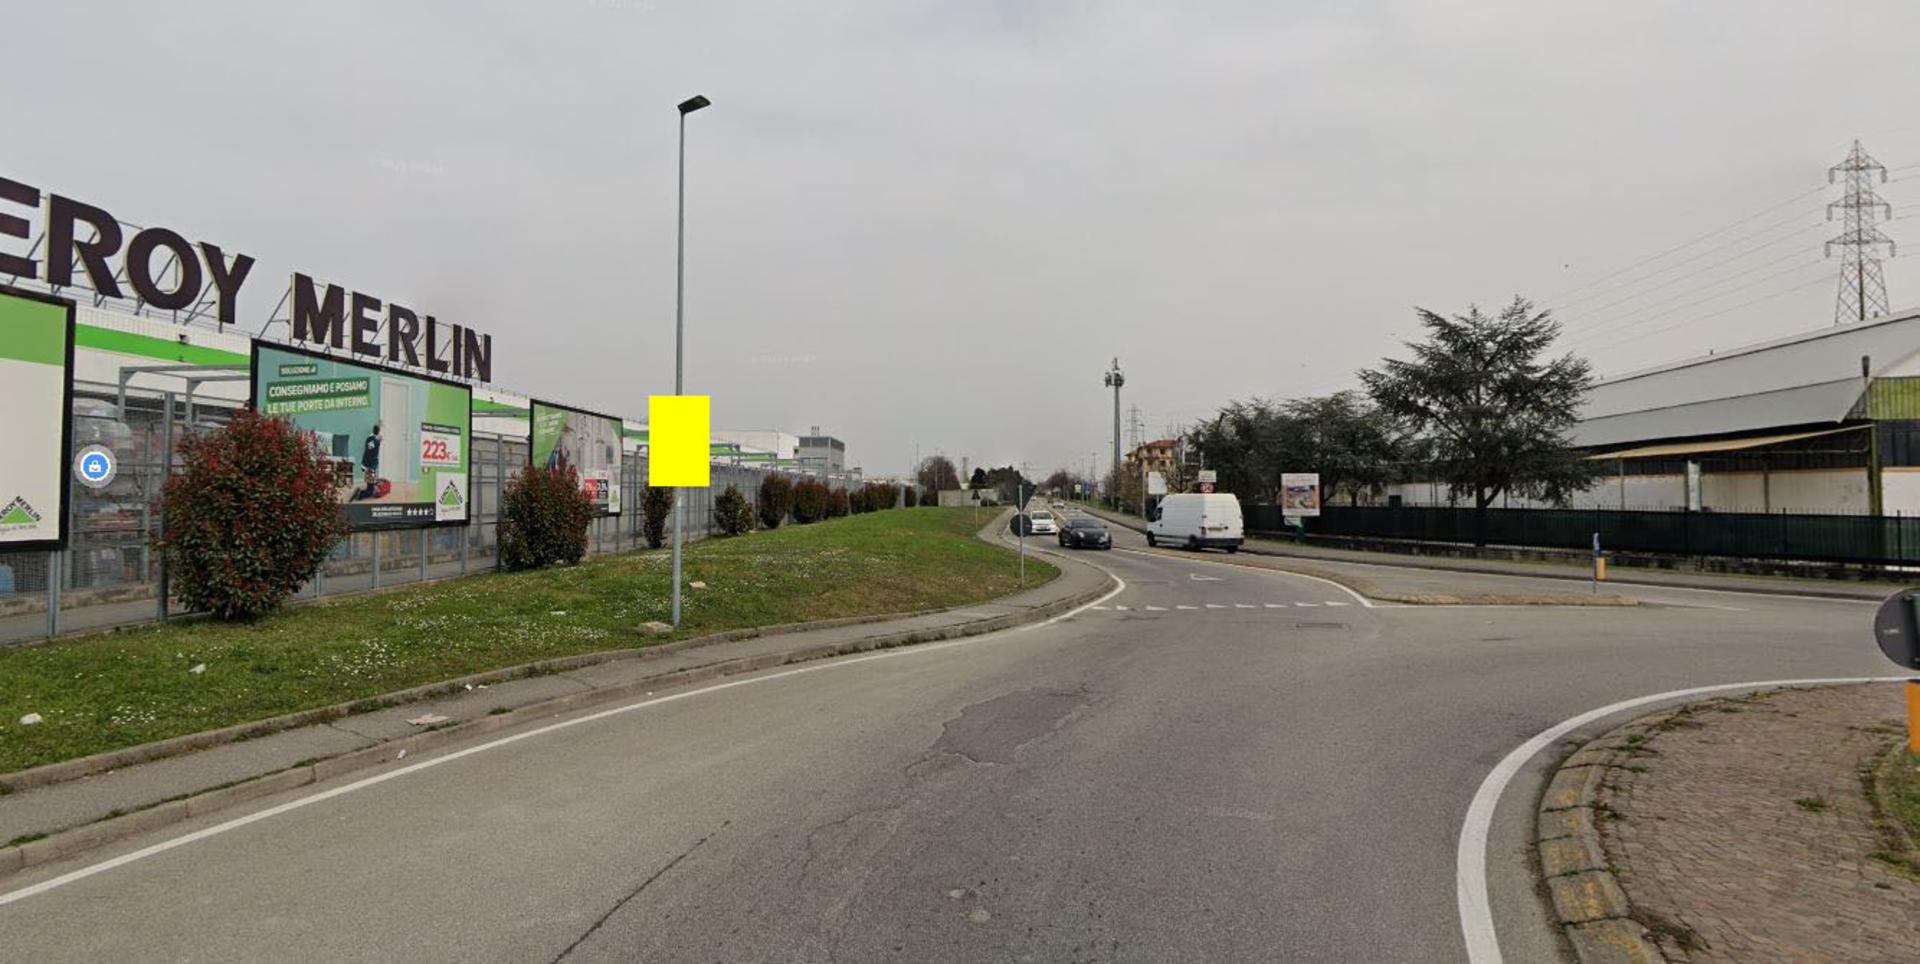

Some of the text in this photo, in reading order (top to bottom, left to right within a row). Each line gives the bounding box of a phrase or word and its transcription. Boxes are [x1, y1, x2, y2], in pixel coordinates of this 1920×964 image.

[292, 272, 492, 383] MERLIN
[269, 380, 368, 398] CONSEGNIAMO E POSIAMO
[267, 402, 279, 414] LE
[280, 401, 297, 413] TUE
[297, 399, 323, 412] PORTE
[324, 398, 335, 409] DA
